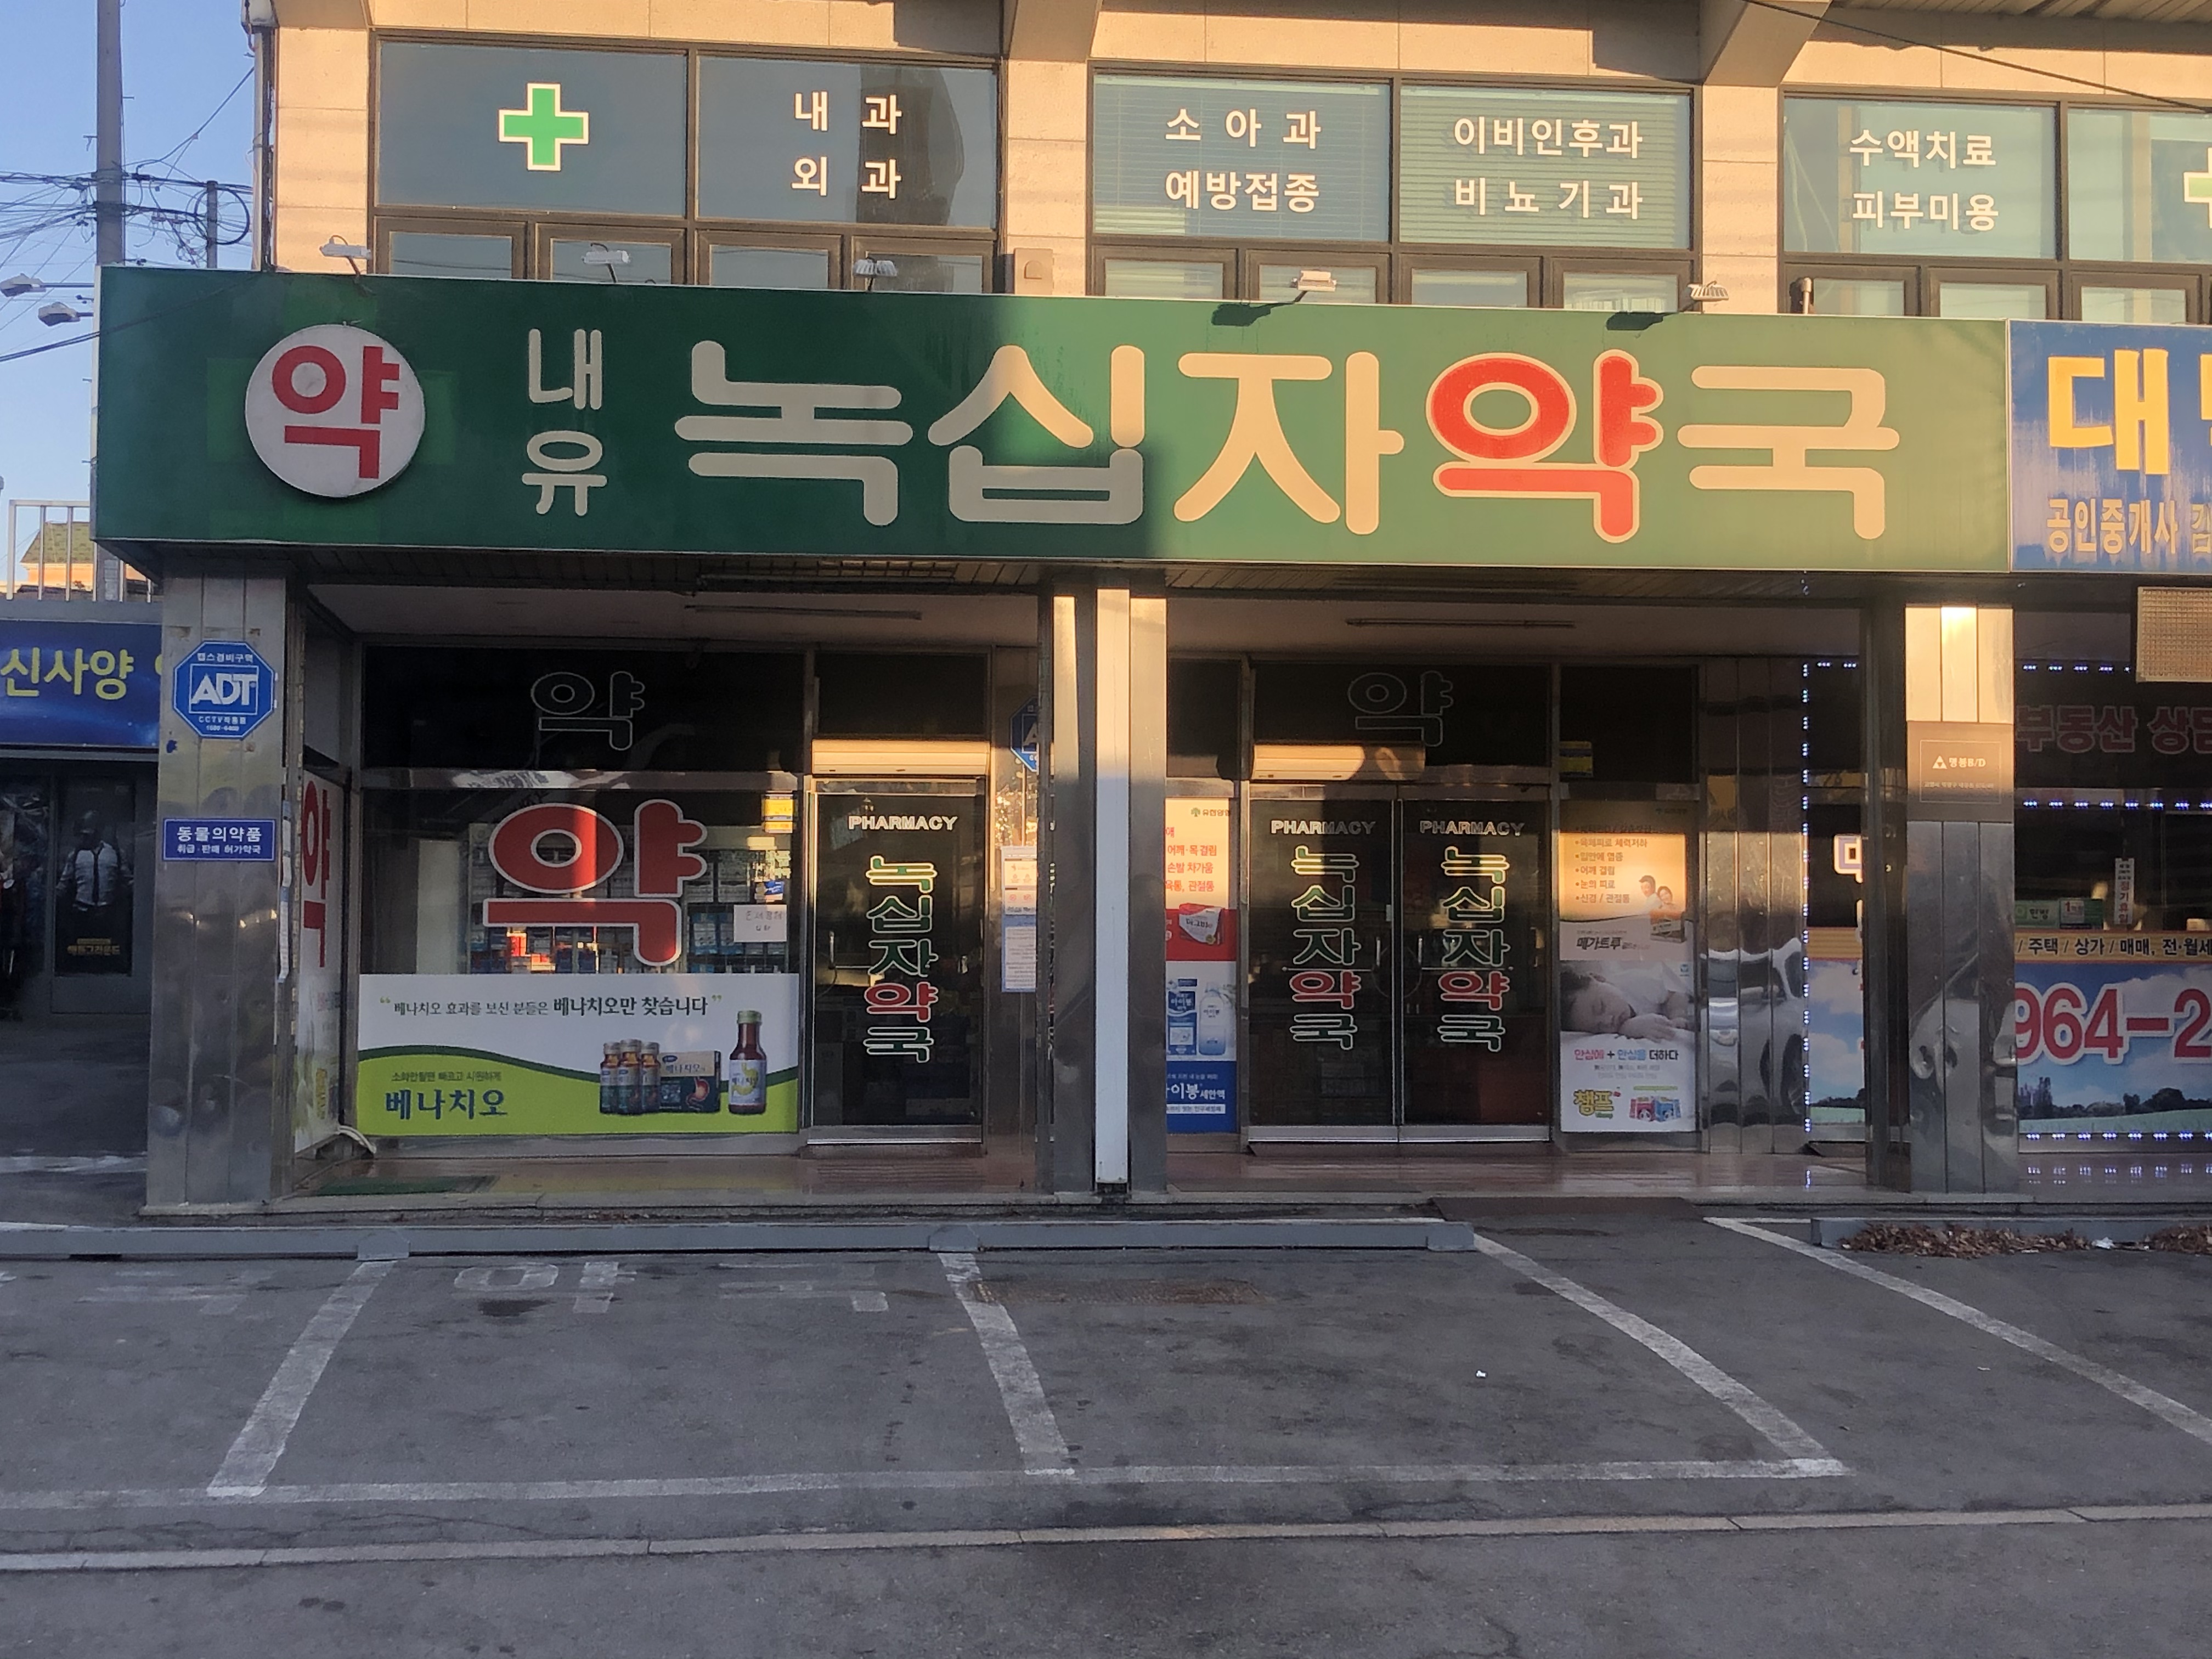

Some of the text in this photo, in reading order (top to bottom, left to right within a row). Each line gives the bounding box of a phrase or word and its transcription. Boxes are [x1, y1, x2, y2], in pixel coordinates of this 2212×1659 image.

[1454, 116, 1643, 159] 이비인후과
[1849, 129, 1997, 169] 수액치료
[1164, 171, 1321, 213] 예방접종
[1852, 191, 2000, 232] 피부미용
[271, 345, 400, 479] 약
[2047, 348, 2212, 475] 대
[674, 339, 1900, 543] 녹십자약국
[2047, 498, 2178, 554] 공인중개사
[0, 646, 134, 701] 신사양
[191, 673, 258, 706] ADT
[530, 671, 645, 751] 약
[1347, 671, 1454, 747] 약
[2016, 705, 2138, 753] 부동산
[177, 826, 262, 842] 동물의약품
[848, 816, 958, 831] PHARMACY
[1271, 820, 1376, 835] PHARMACY
[1420, 820, 1525, 836] PHARMACY
[302, 781, 331, 968] 약
[483, 799, 708, 966] 약
[863, 855, 939, 1063] 녹십자약국
[1289, 845, 1362, 1051] 녹십자약국
[1437, 846, 1511, 1052] 녹십자약국
[1576, 936, 1622, 950] 메가트루
[2028, 938, 2058, 955] 주택
[2075, 938, 2105, 955] 상가
[486, 1001, 509, 1015] 보신
[554, 996, 637, 1016] 베나치오만
[1649, 1049, 1679, 1060] 더하다
[385, 1089, 508, 1120] 베나치오
[1166, 1082, 1200, 1100] 이봉
